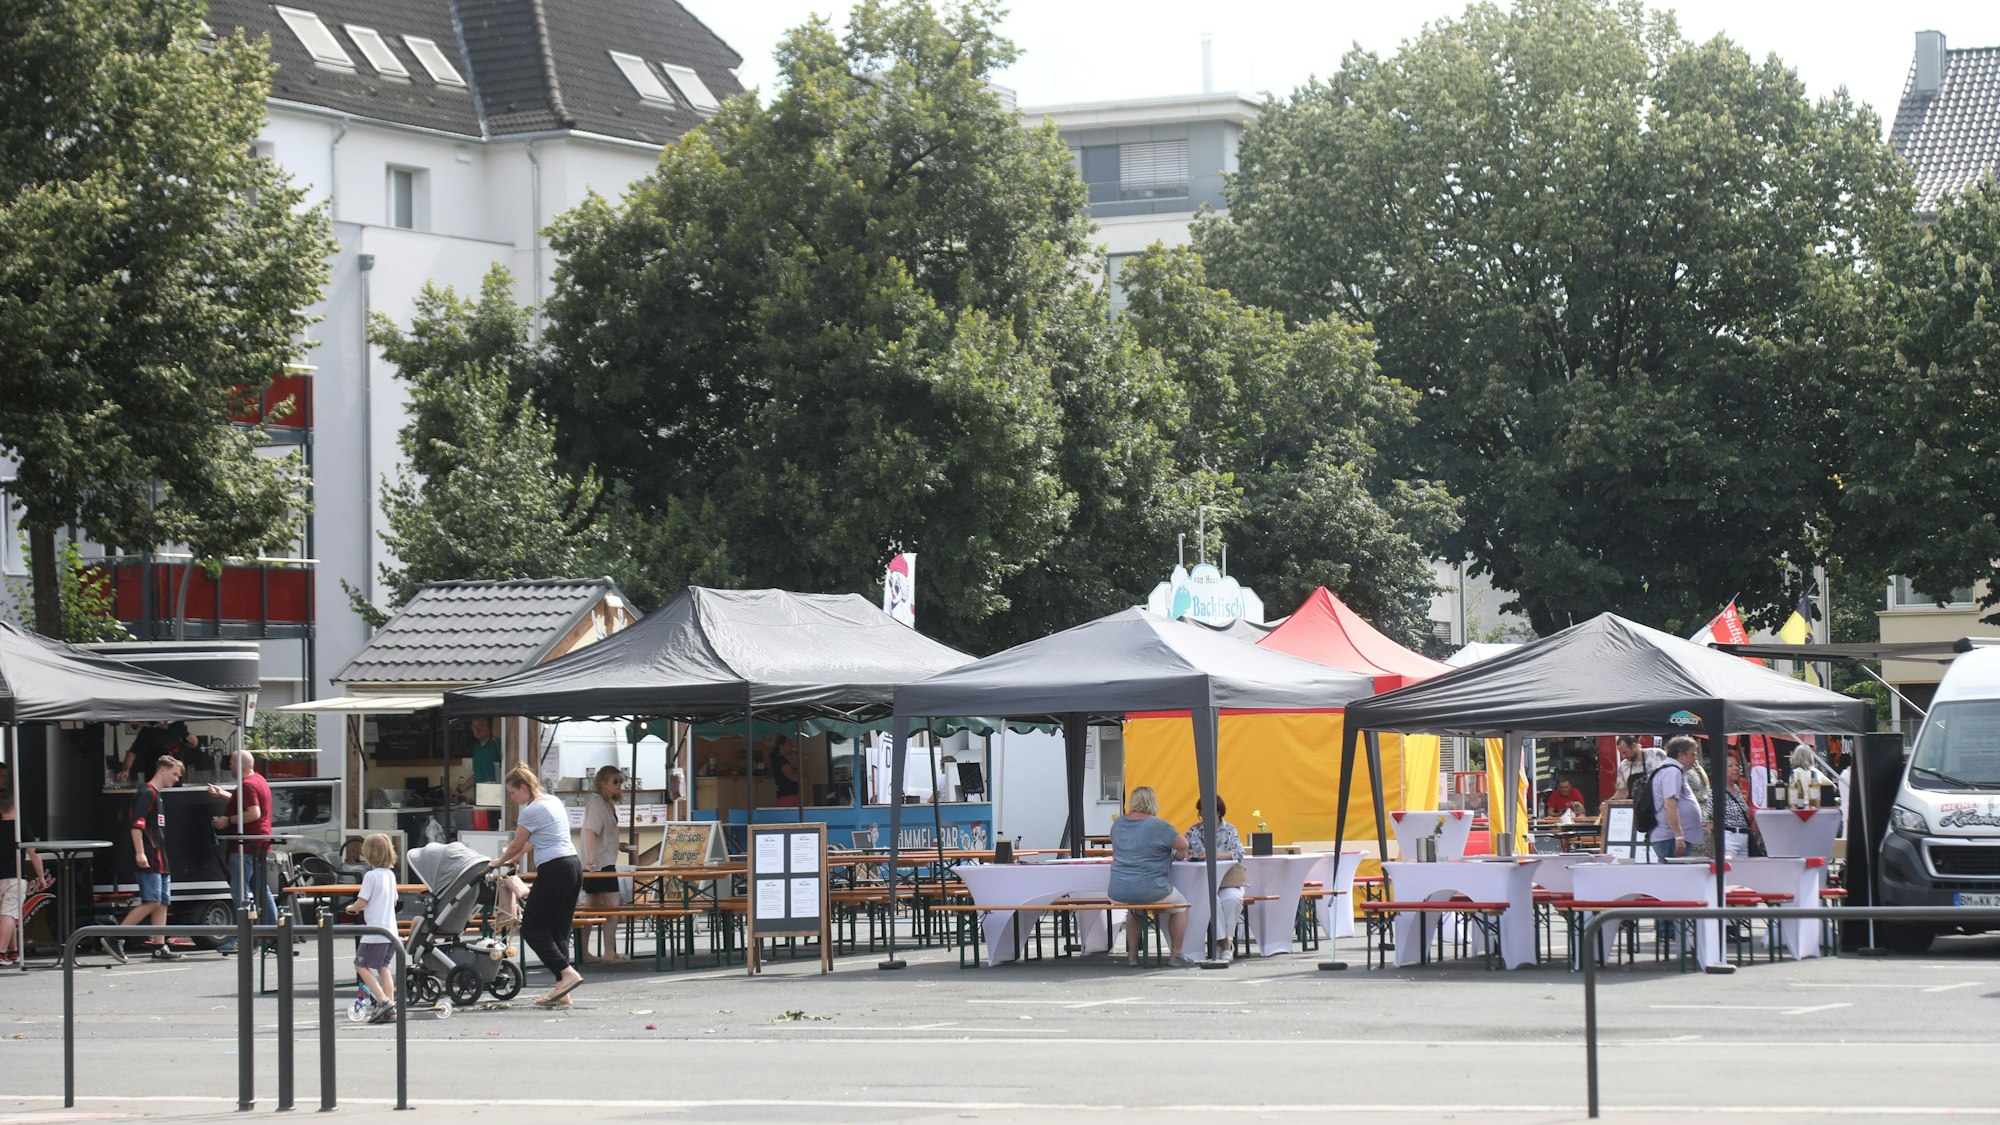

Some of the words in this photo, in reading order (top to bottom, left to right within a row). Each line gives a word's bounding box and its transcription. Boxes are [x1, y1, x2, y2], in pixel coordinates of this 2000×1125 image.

[1192, 595, 1243, 618] Backfisch
[676, 831, 704, 843] Hirsch-
[672, 850, 701, 861] Burger
